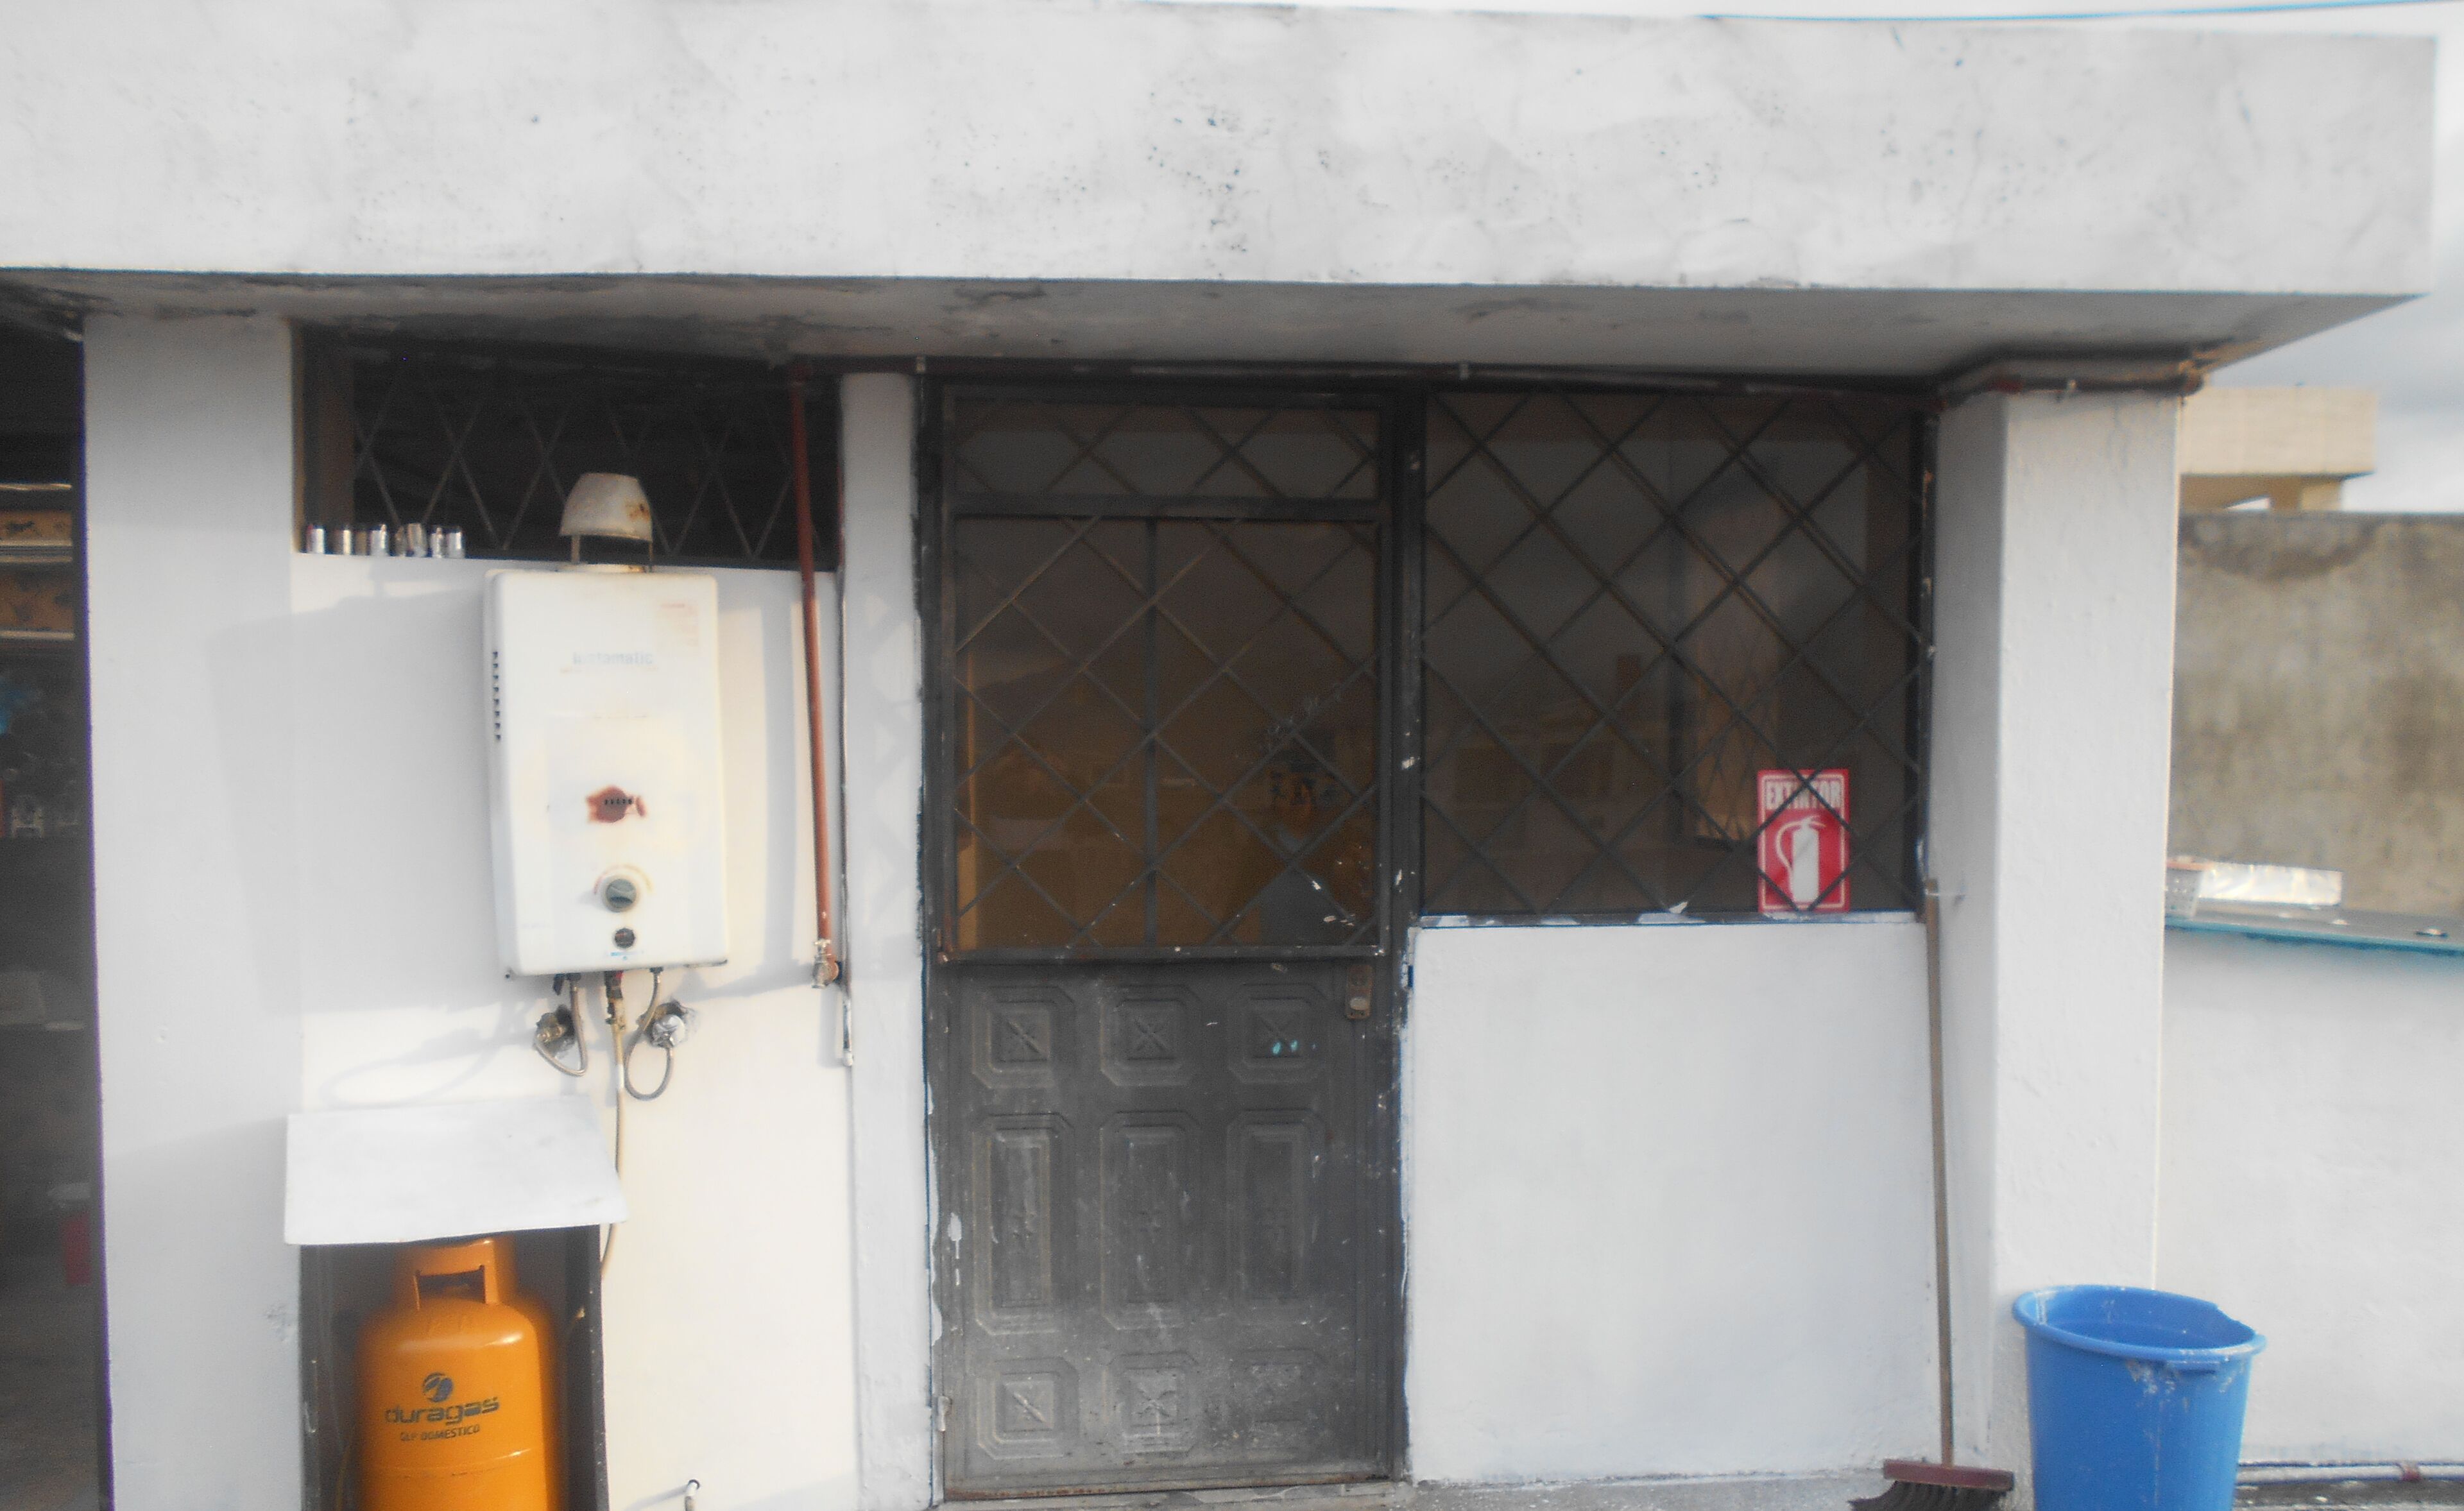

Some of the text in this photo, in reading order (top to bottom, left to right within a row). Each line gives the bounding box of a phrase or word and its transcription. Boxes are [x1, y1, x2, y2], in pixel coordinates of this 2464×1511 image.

[1765, 780, 1841, 810] EXTINTOR
[384, 1396, 501, 1426] duragas
[420, 1423, 481, 1441] DOMESTICO
